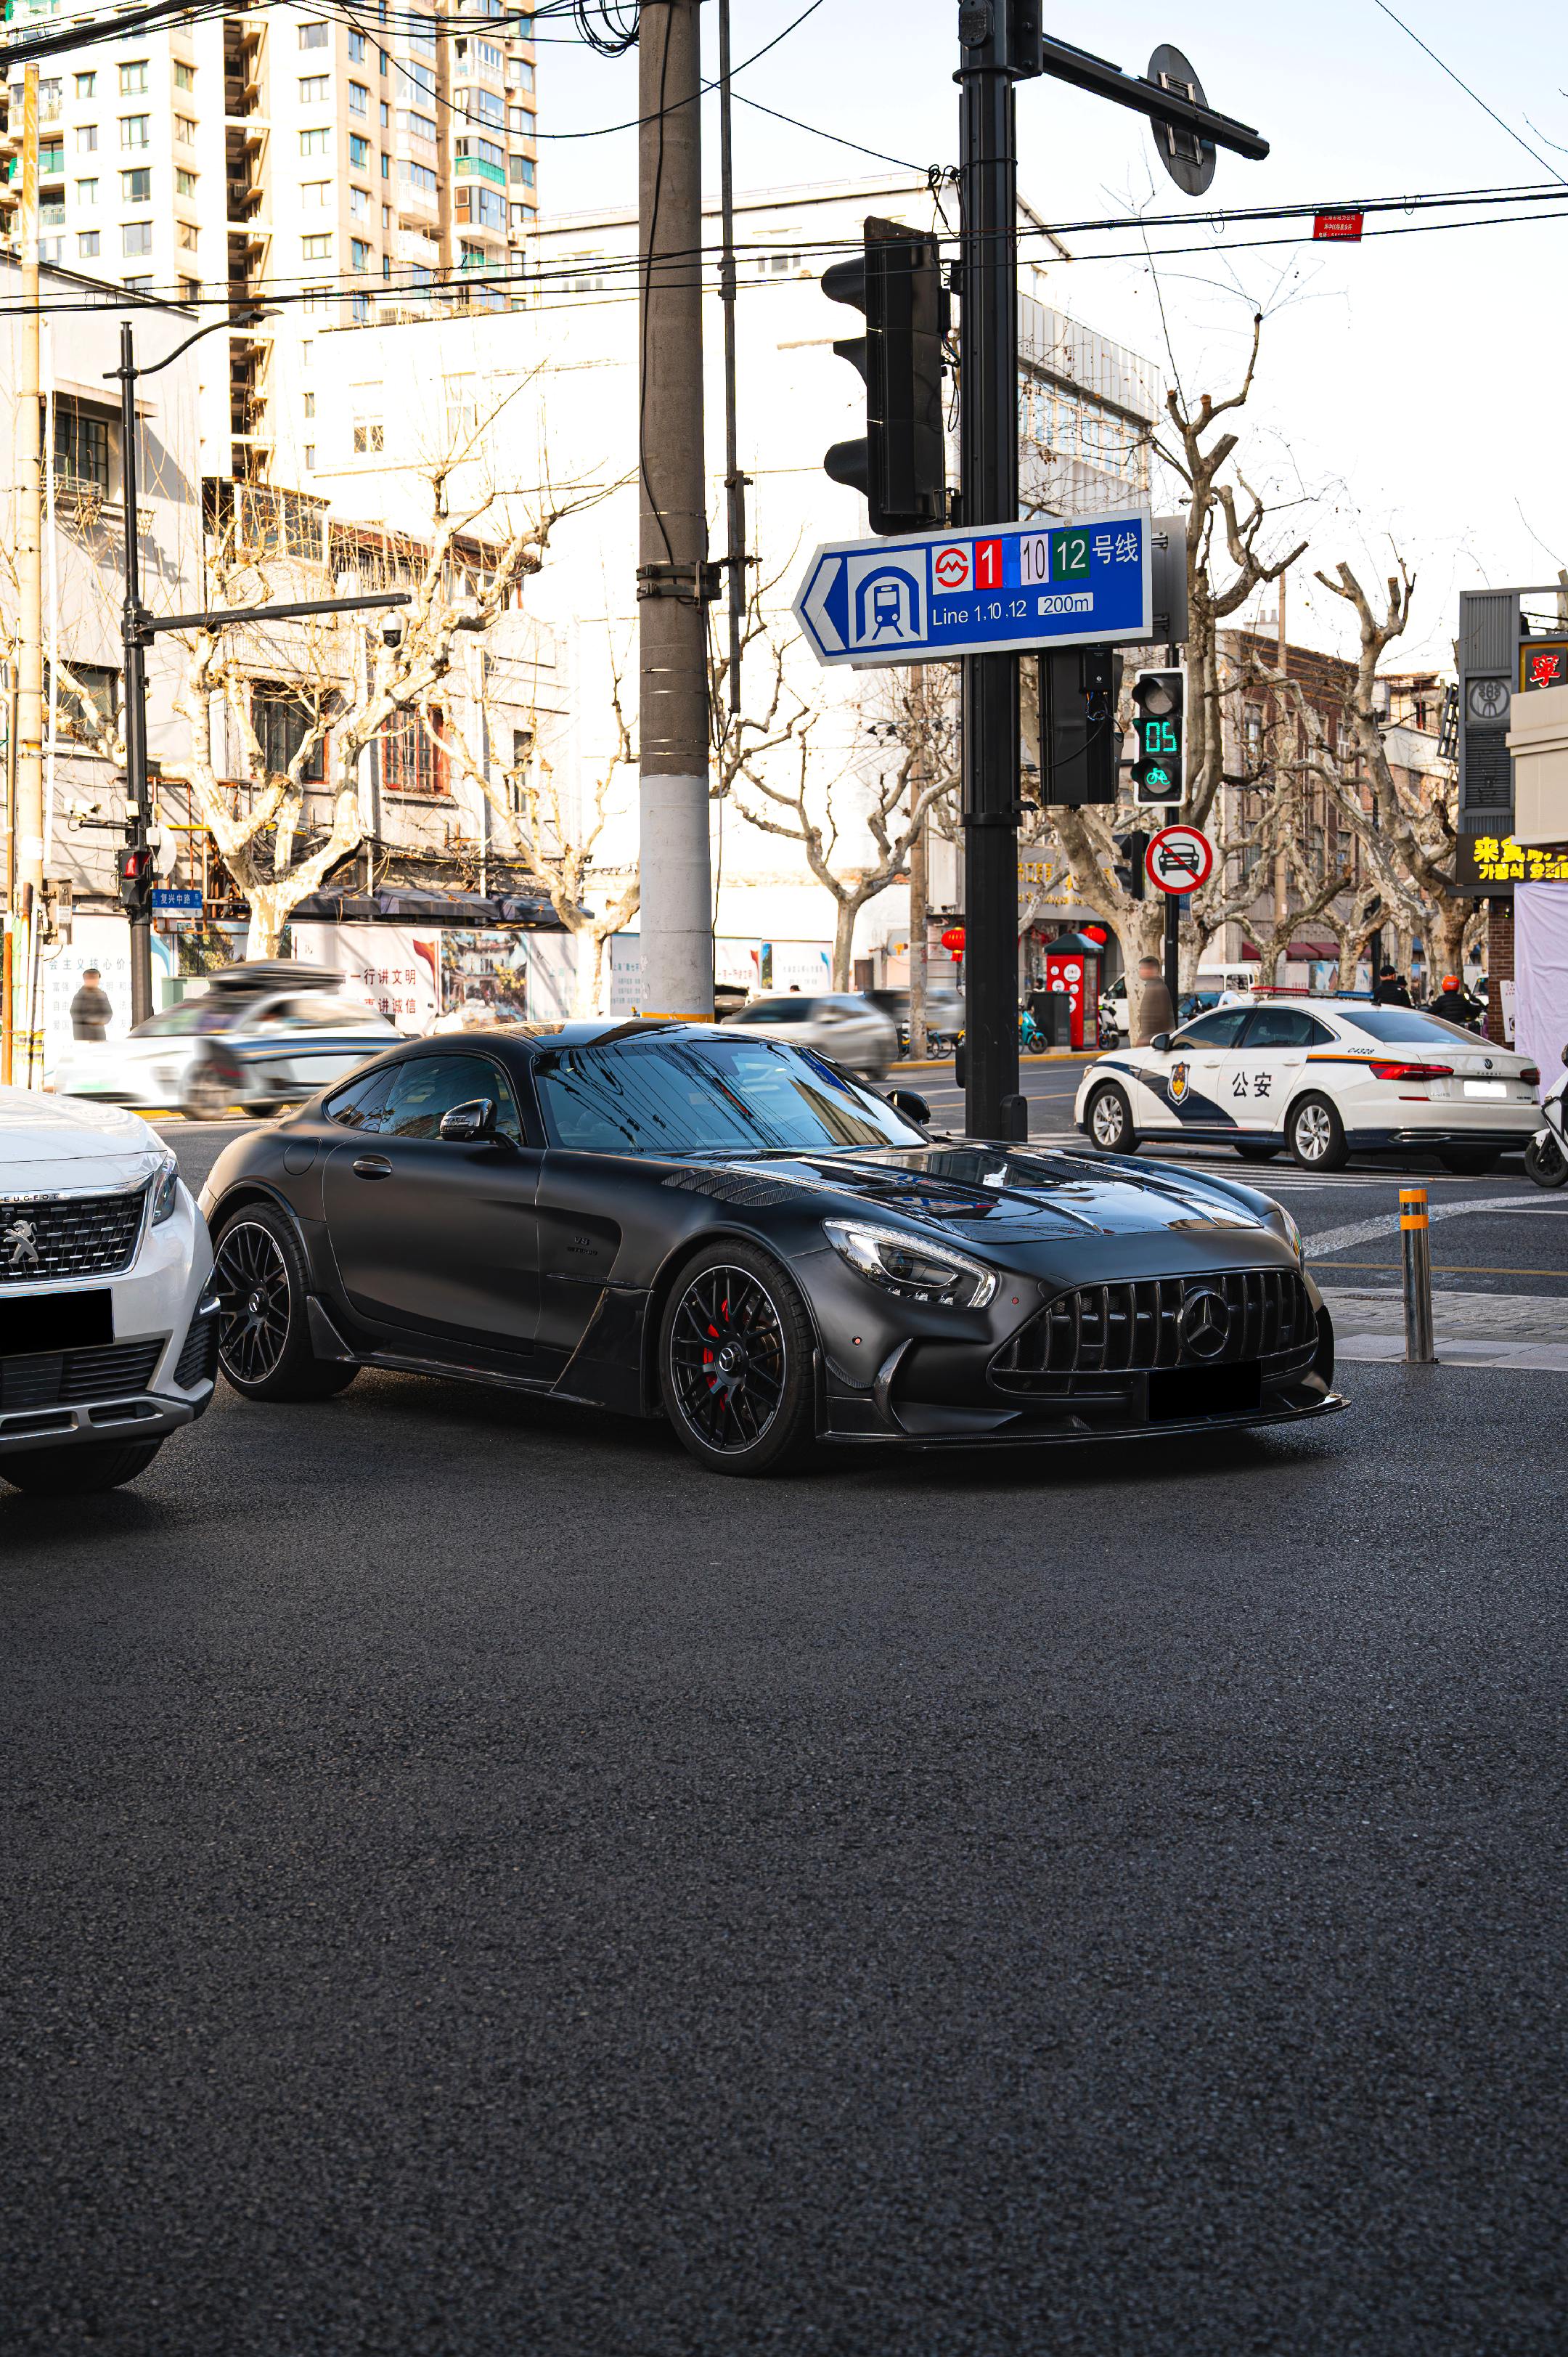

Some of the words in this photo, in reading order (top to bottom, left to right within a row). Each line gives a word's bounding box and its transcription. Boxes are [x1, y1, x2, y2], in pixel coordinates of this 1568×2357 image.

[981, 545, 994, 584] 1
[1024, 540, 1045, 579] 10
[1057, 540, 1086, 571] 12
[1092, 532, 1138, 563] 号线
[1044, 596, 1089, 614] 200m
[933, 609, 968, 626] Line
[1146, 722, 1177, 752] 05
[160, 893, 190, 905] 复兴中路
[49, 958, 131, 971] 会主义核心价
[343, 969, 416, 985] 一行讲文明
[1232, 1071, 1272, 1097] 公安
[0, 1194, 59, 1202] EUGEOT
